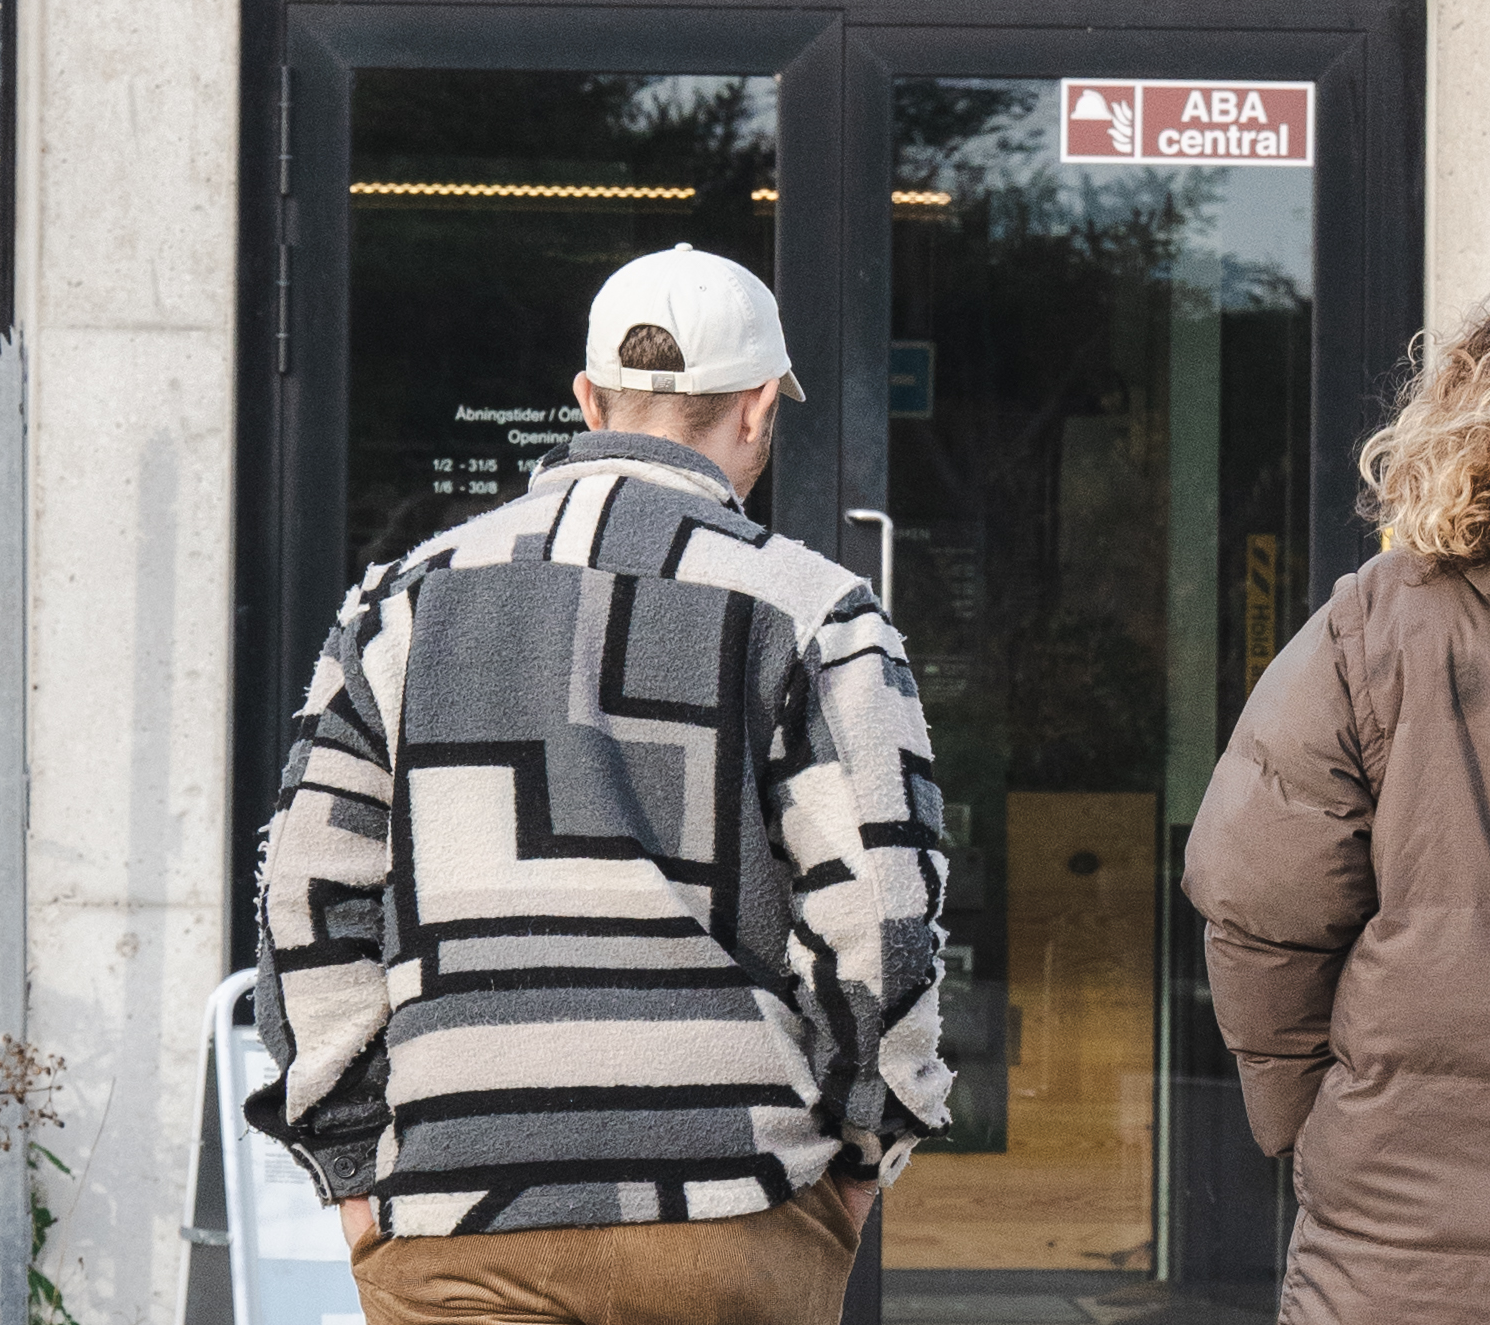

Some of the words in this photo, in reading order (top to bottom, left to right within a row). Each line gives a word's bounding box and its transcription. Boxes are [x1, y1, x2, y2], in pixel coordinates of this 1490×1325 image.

[1181, 88, 1269, 124] ABA
[1157, 123, 1290, 156] central
[455, 404, 545, 424] Åbningstider
[432, 458, 454, 472] 1/2
[468, 458, 498, 473] 31/5
